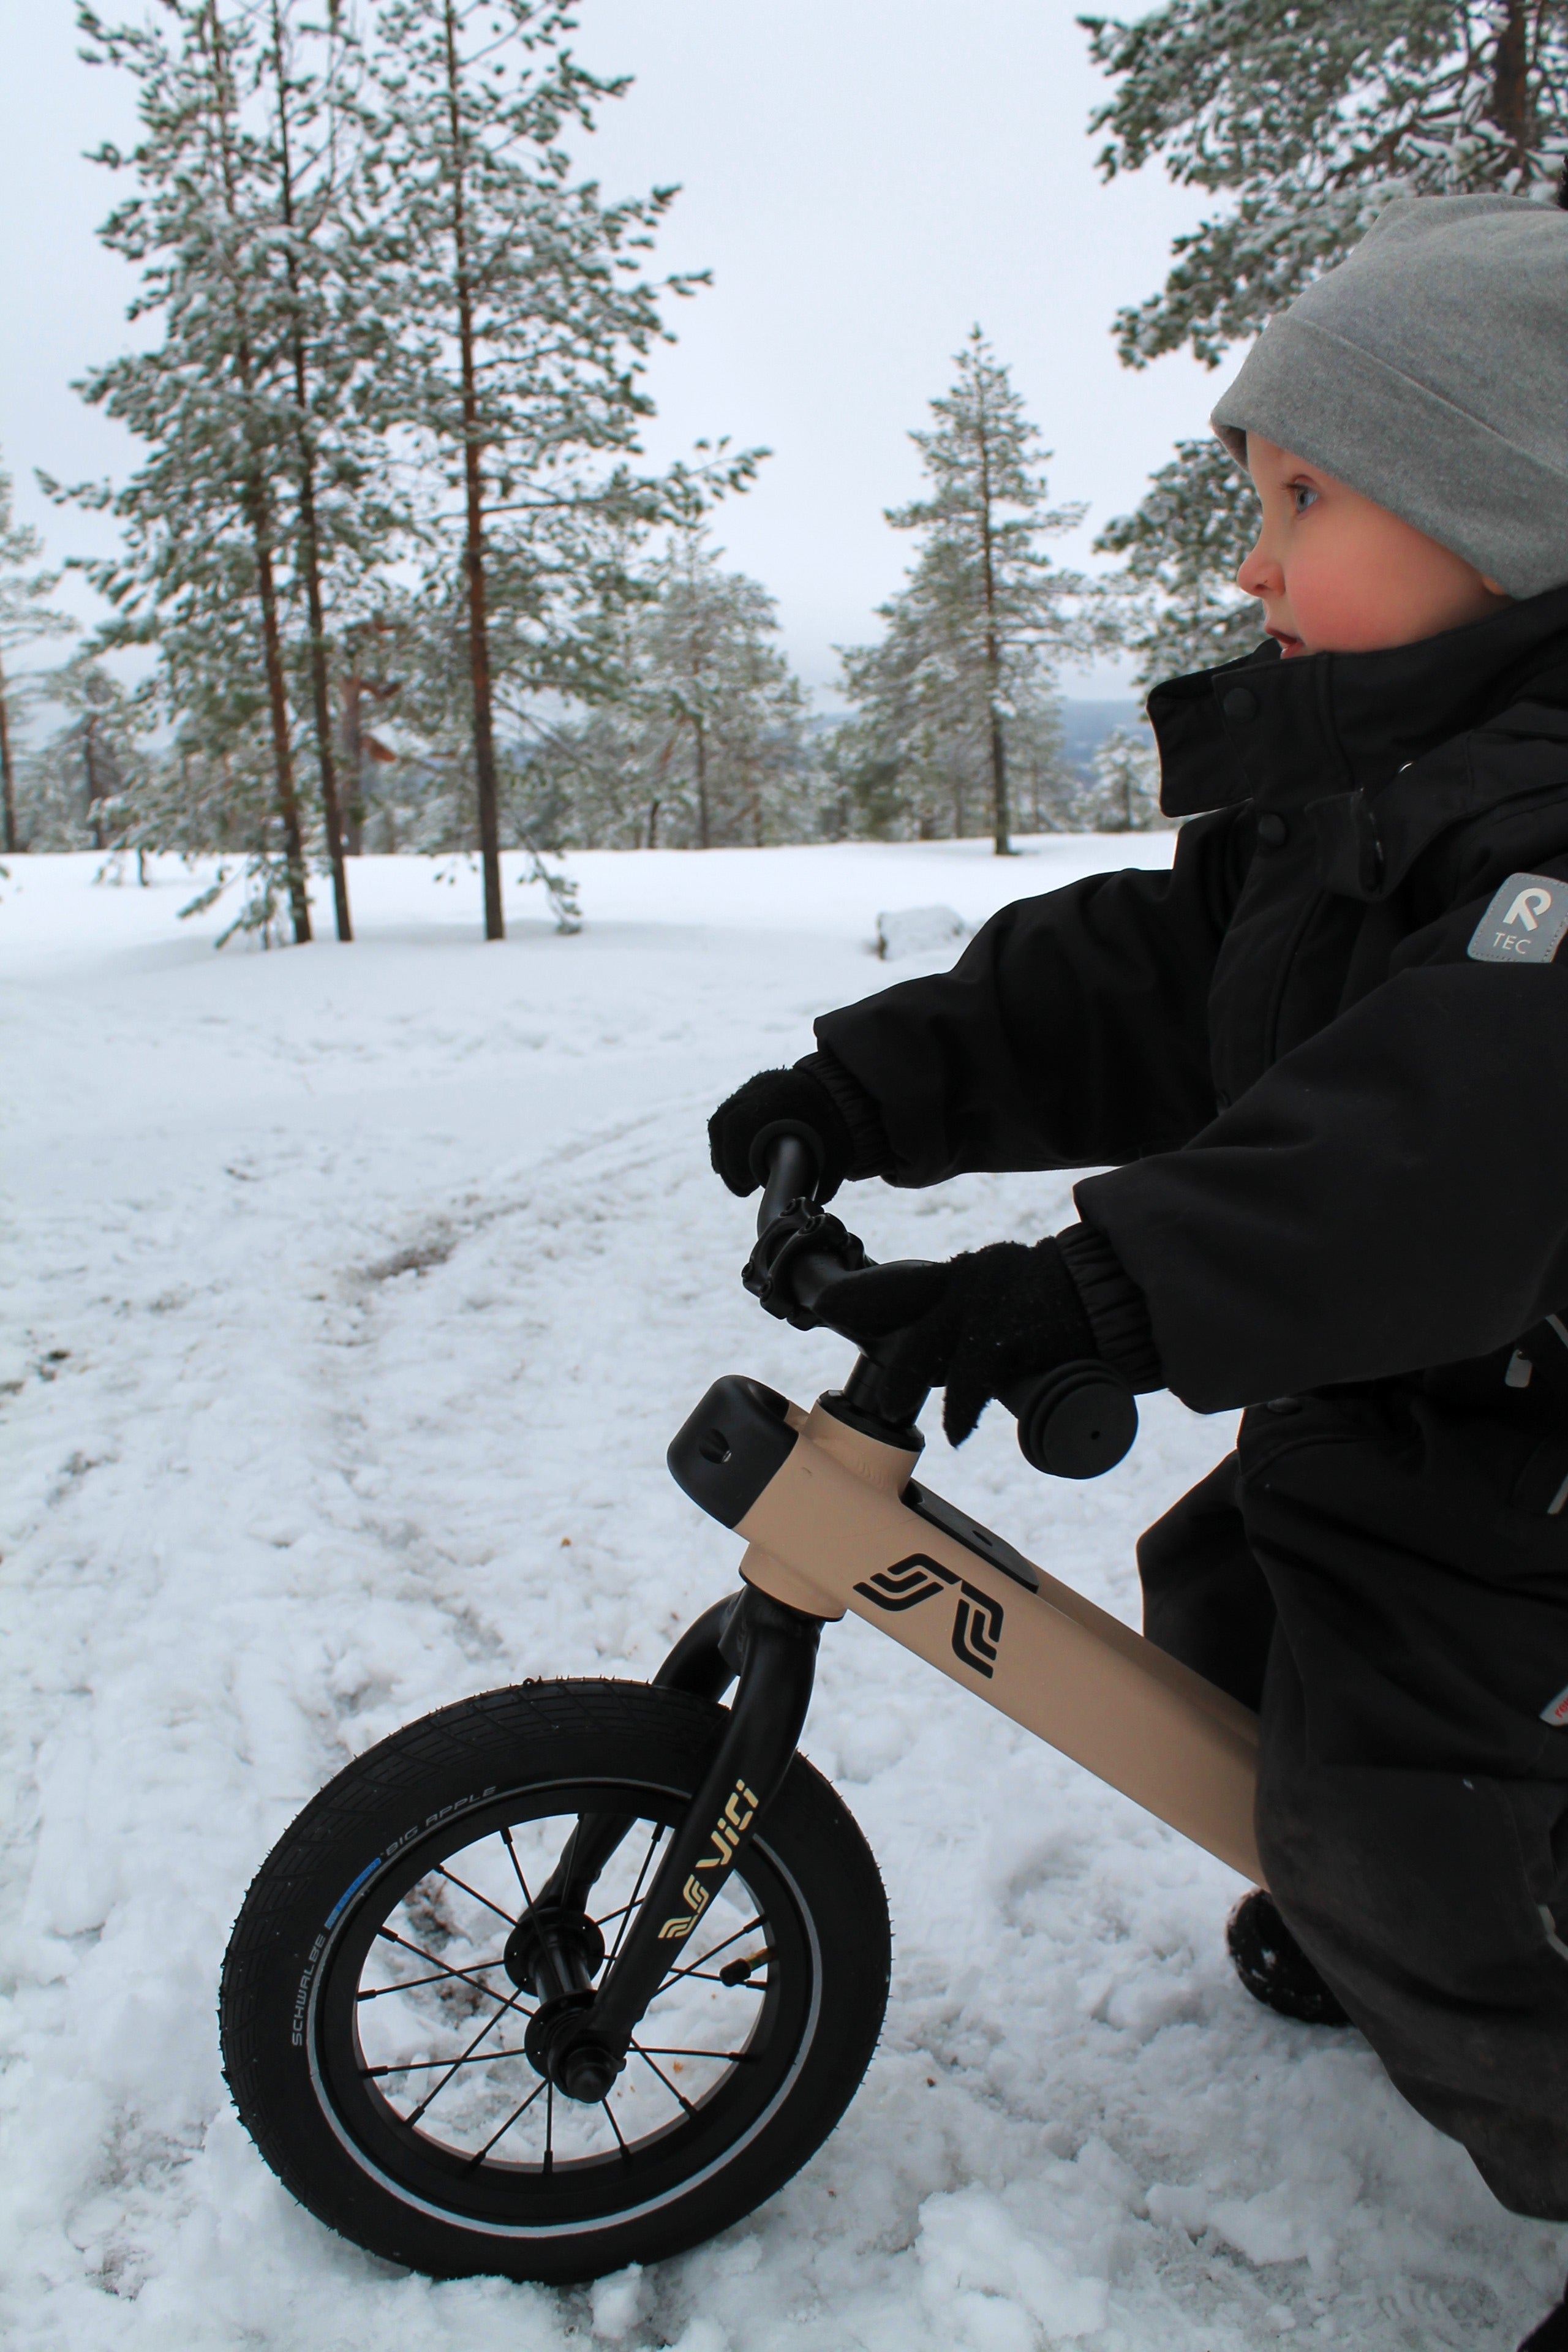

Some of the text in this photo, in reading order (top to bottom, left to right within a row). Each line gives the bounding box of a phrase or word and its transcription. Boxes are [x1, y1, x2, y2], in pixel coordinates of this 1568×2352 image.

[1493, 932, 1531, 954] TEC
[292, 1785, 497, 2046] SCHWALBE BIG APPLE
